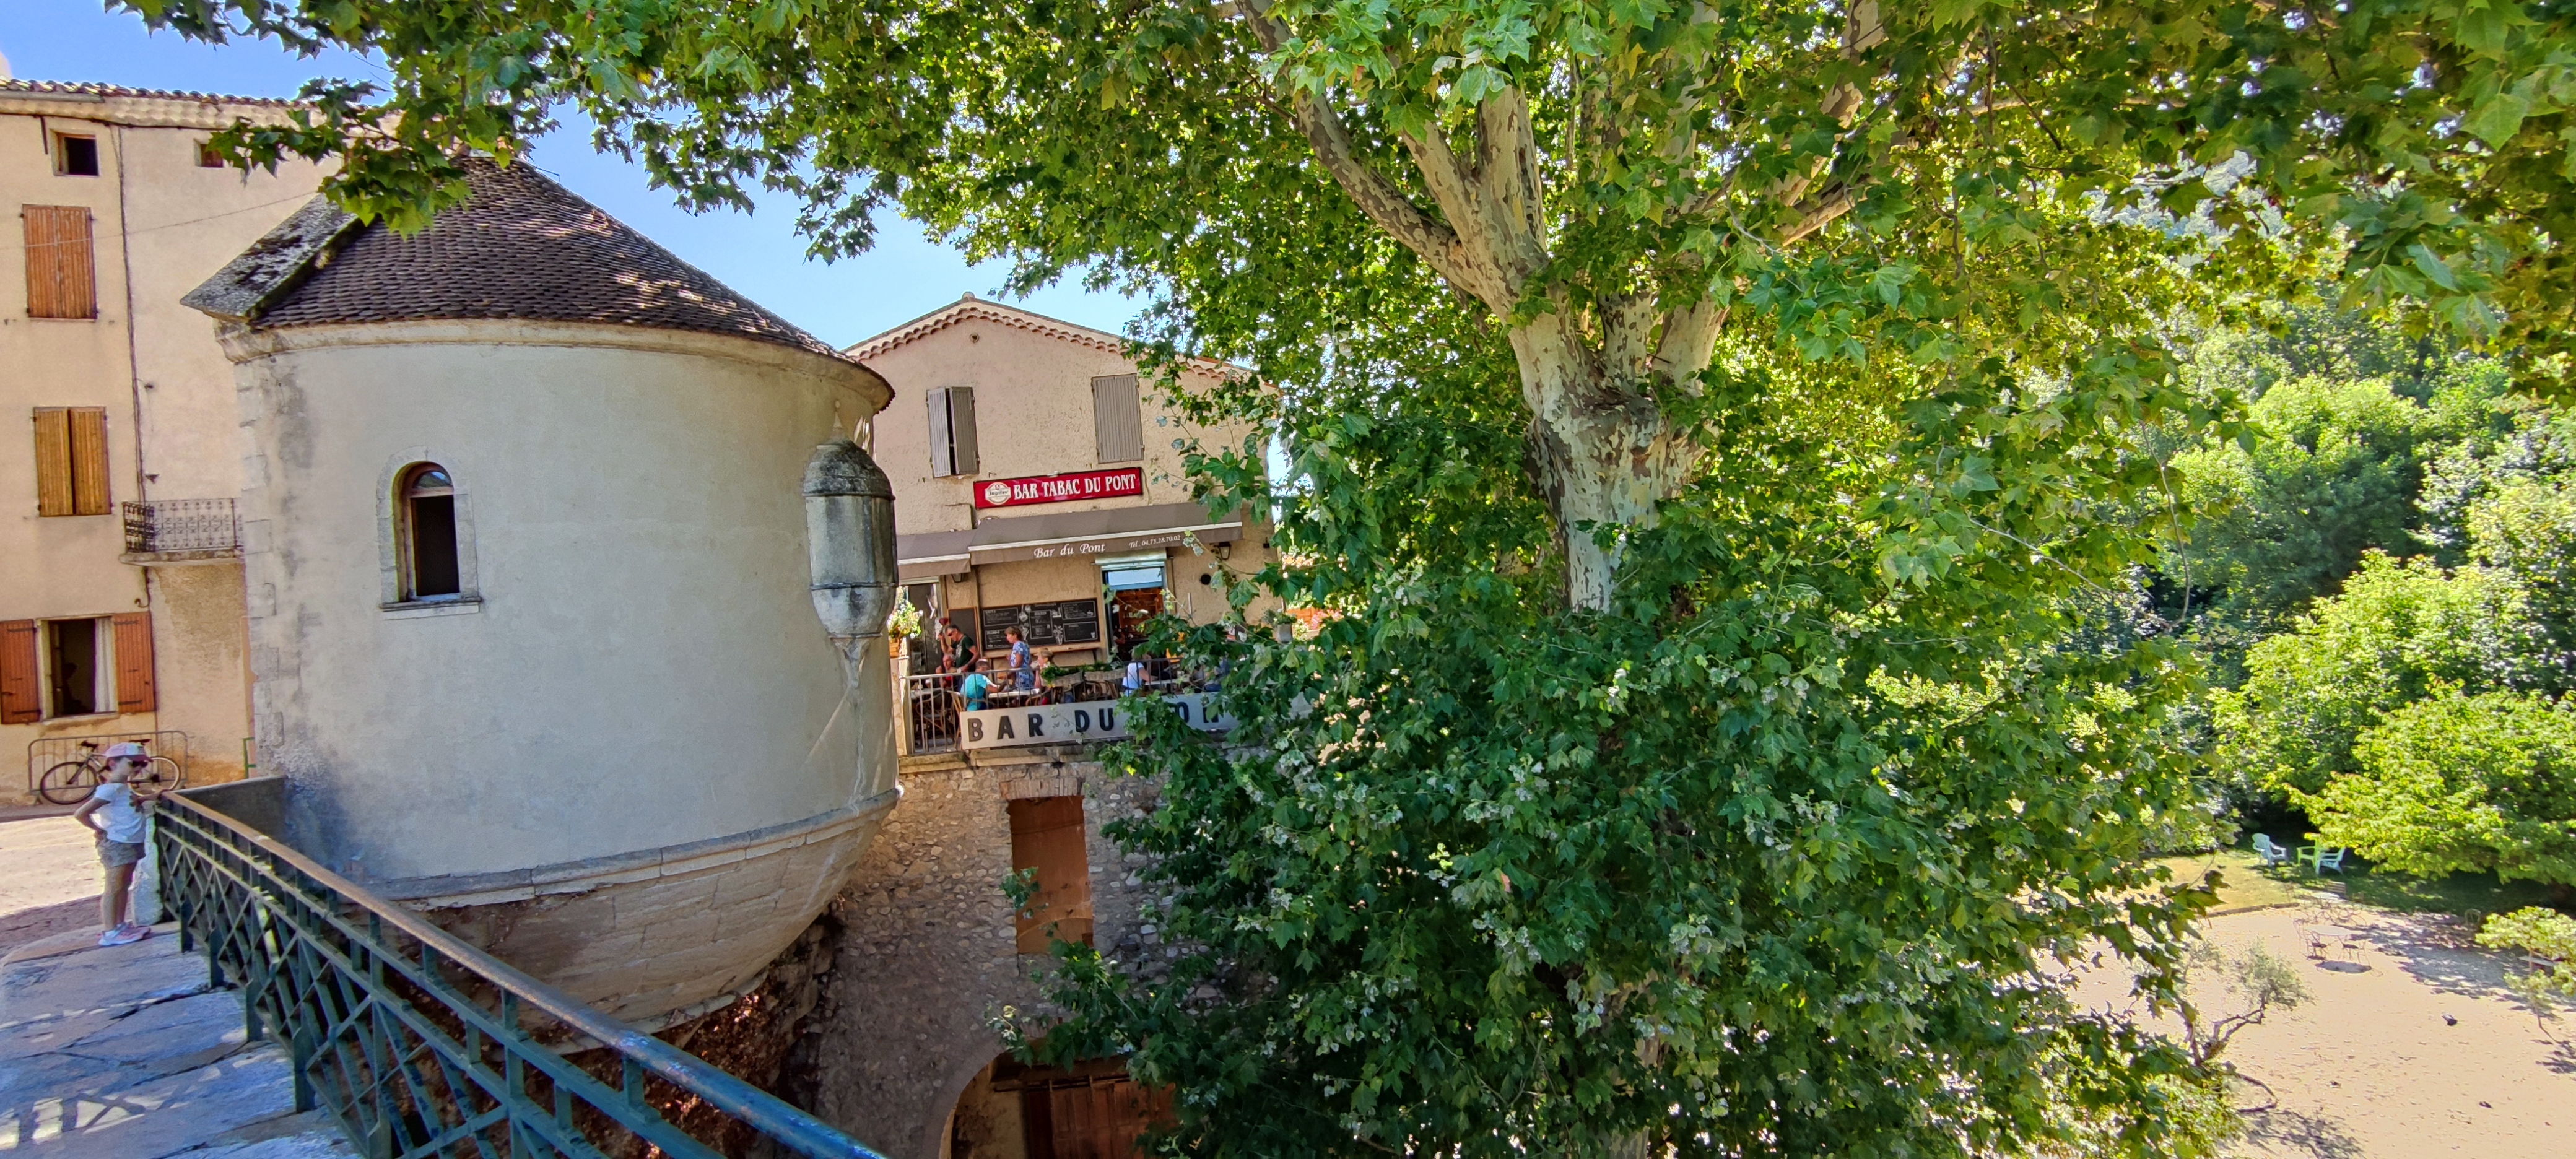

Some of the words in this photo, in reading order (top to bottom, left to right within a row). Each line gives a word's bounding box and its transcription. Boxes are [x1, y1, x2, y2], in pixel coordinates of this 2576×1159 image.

[1014, 484, 1039, 500] BAR
[1042, 479, 1081, 497] TABAC
[1084, 477, 1101, 493] DU
[1105, 474, 1136, 492] PONT
[1033, 547, 1055, 558] Bar
[1060, 543, 1074, 556] du
[1079, 543, 1106, 554] Pont
[967, 713, 1044, 742] BAR
[1074, 708, 1115, 733] DU
